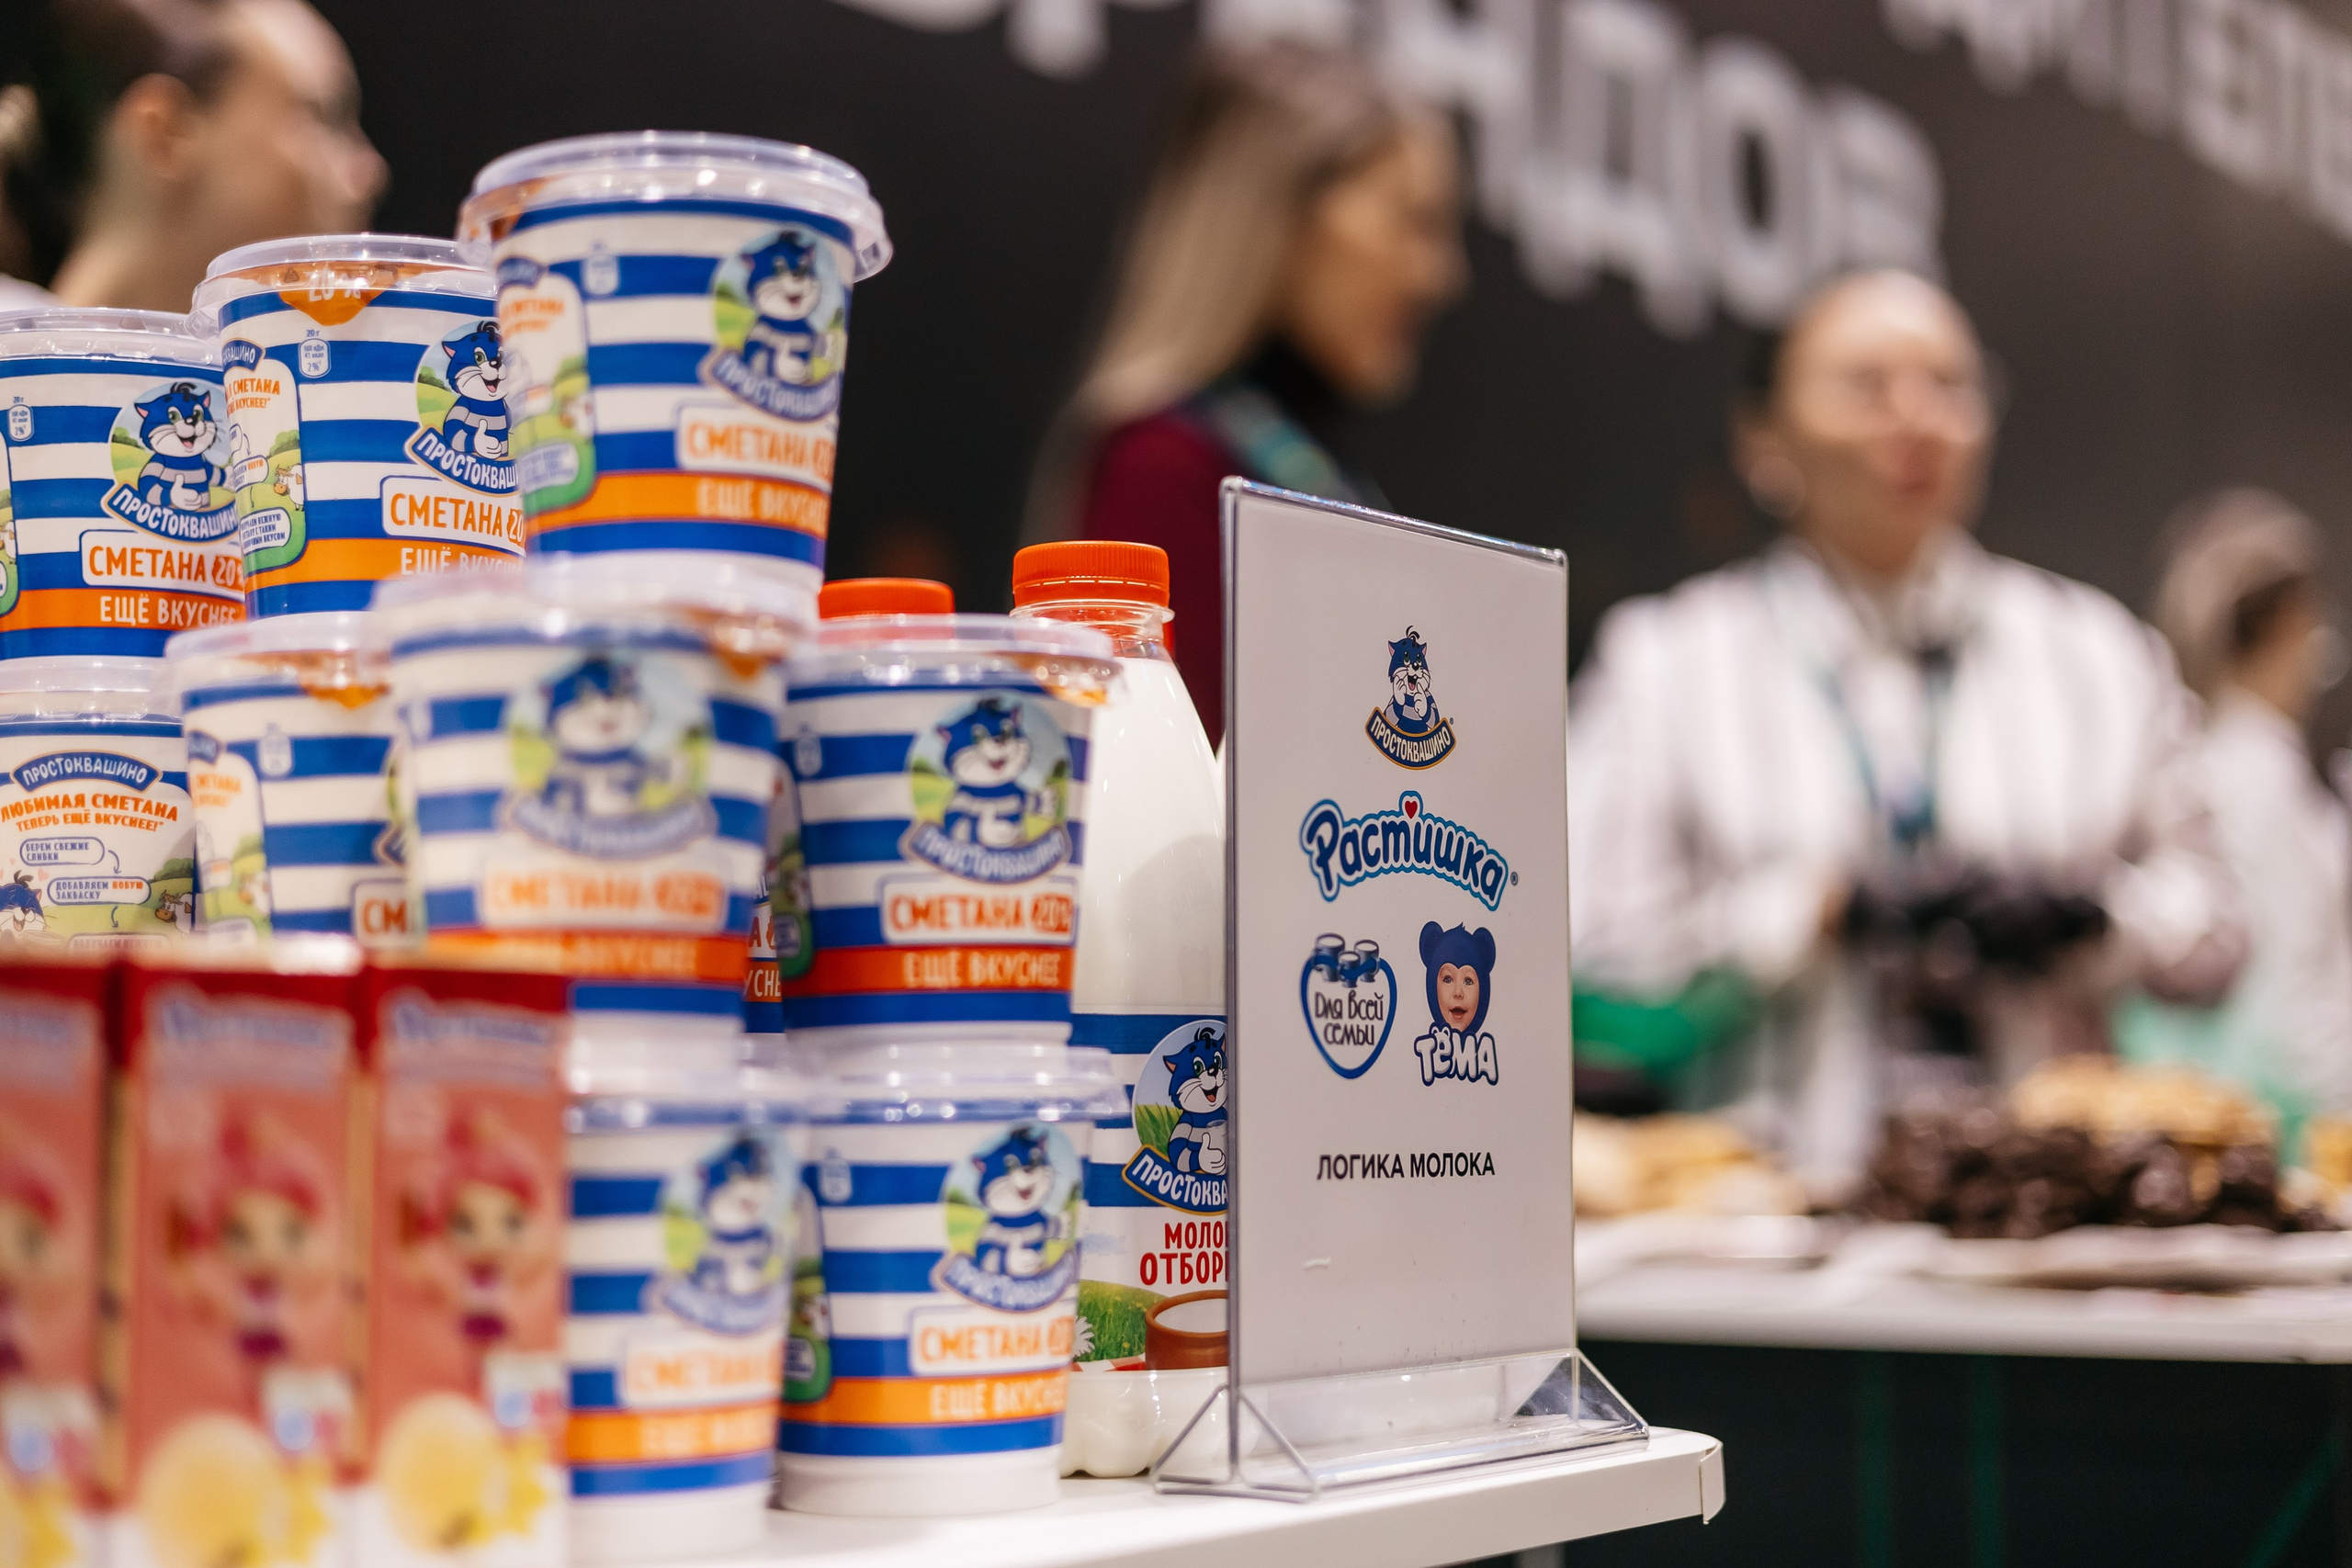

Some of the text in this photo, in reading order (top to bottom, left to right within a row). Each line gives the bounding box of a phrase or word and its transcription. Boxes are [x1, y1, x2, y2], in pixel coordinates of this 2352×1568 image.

[111, 487, 239, 539] ПРОСТОКВАШИН
[390, 492, 503, 538] СМЕТАНА
[88, 545, 208, 583] СМЕТАНА
[100, 592, 151, 626] ЕЩЁ
[1370, 715, 1452, 763] ПРОСТОКВАШИНО
[21, 756, 149, 786] ПРОСТОКВАШИНО
[0, 792, 87, 824] ЛЮБИМАЯ
[91, 792, 179, 823] СМЕТАНА
[15, 813, 61, 833] ТЕПЕРЬ
[62, 808, 92, 826] ЕЩЁ
[26, 852, 60, 863] СЛИВКИ
[53, 840, 90, 852] СВЕЖИЕ
[1305, 807, 1505, 903] Растишка
[55, 881, 109, 892] ДОБАВЛЯЕМ
[56, 890, 102, 901] ЗАКВАСКУ
[889, 893, 1024, 933] СМЕТАНА
[1314, 990, 1344, 1021] Для
[1131, 1153, 1229, 1206] ПРОСТОКВА
[1316, 1151, 1497, 1180] ЛОГИКА МОЛОКА
[1164, 1220, 1229, 1250] МОЛО
[1139, 1250, 1229, 1286] ОТБОР
